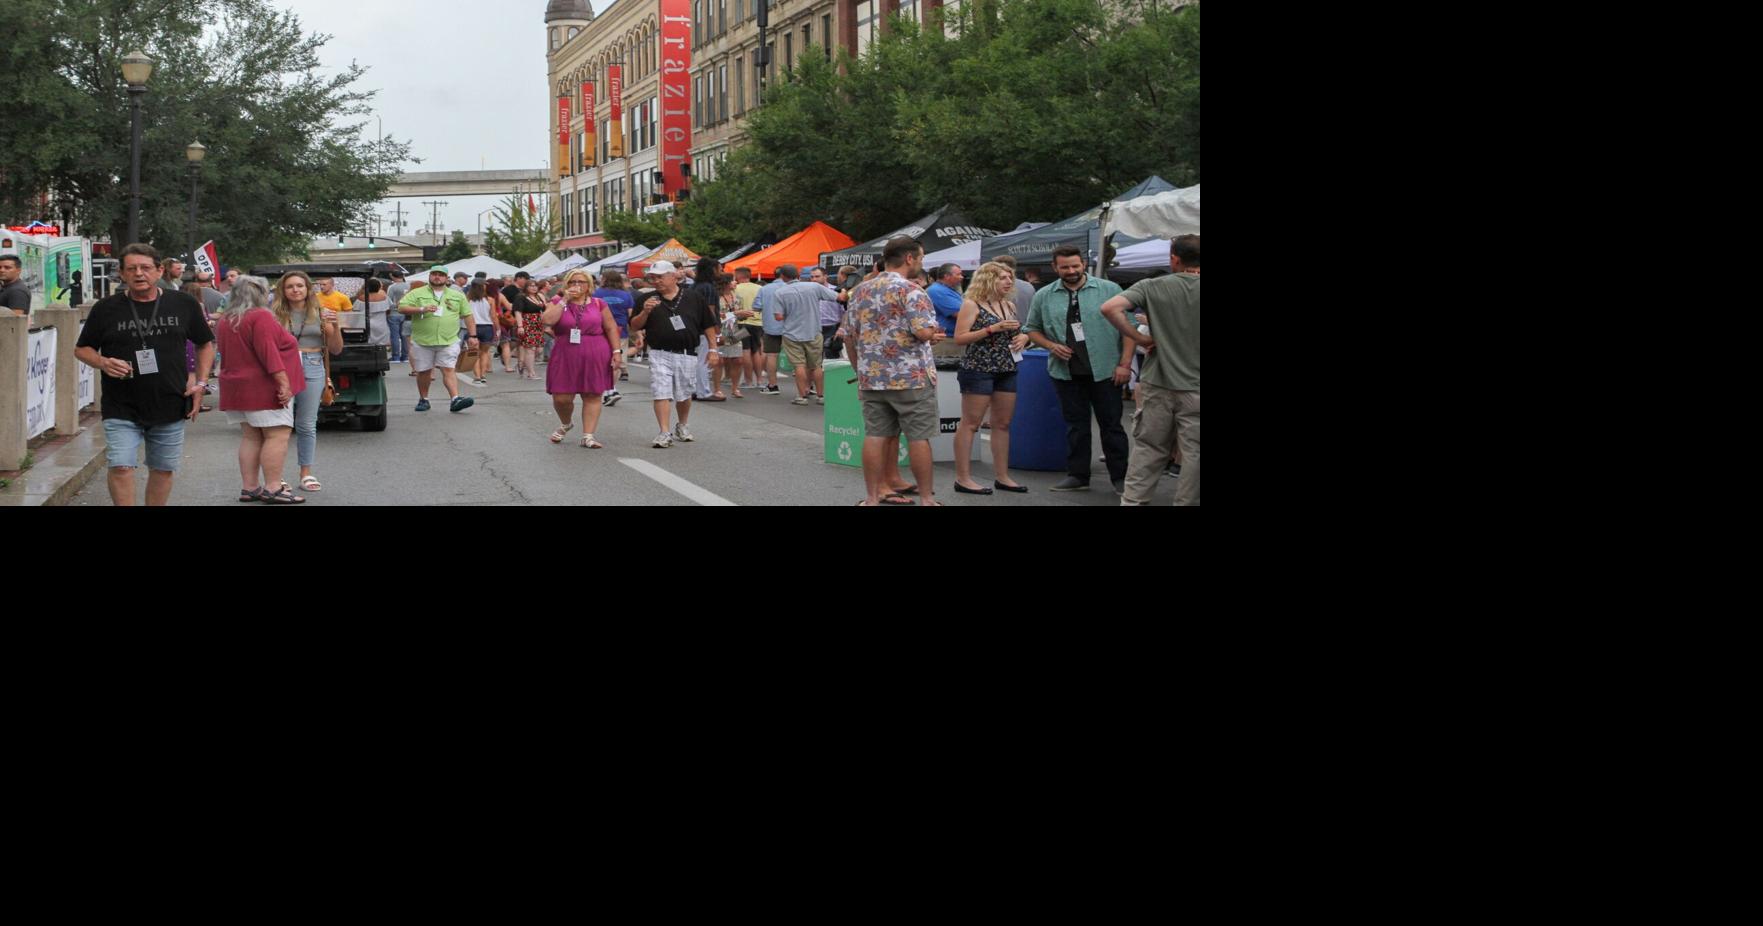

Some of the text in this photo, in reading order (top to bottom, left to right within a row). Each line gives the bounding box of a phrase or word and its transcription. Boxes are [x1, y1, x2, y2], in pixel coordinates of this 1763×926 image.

[611, 77, 621, 107] frazier
[664, 14, 692, 165] frazier
[560, 107, 569, 134] frazier
[584, 93, 593, 121] frazier
[197, 254, 214, 276] OPE
[832, 254, 849, 266] DERBY
[862, 253, 874, 266] USA
[828, 424, 860, 436] Recycle!
